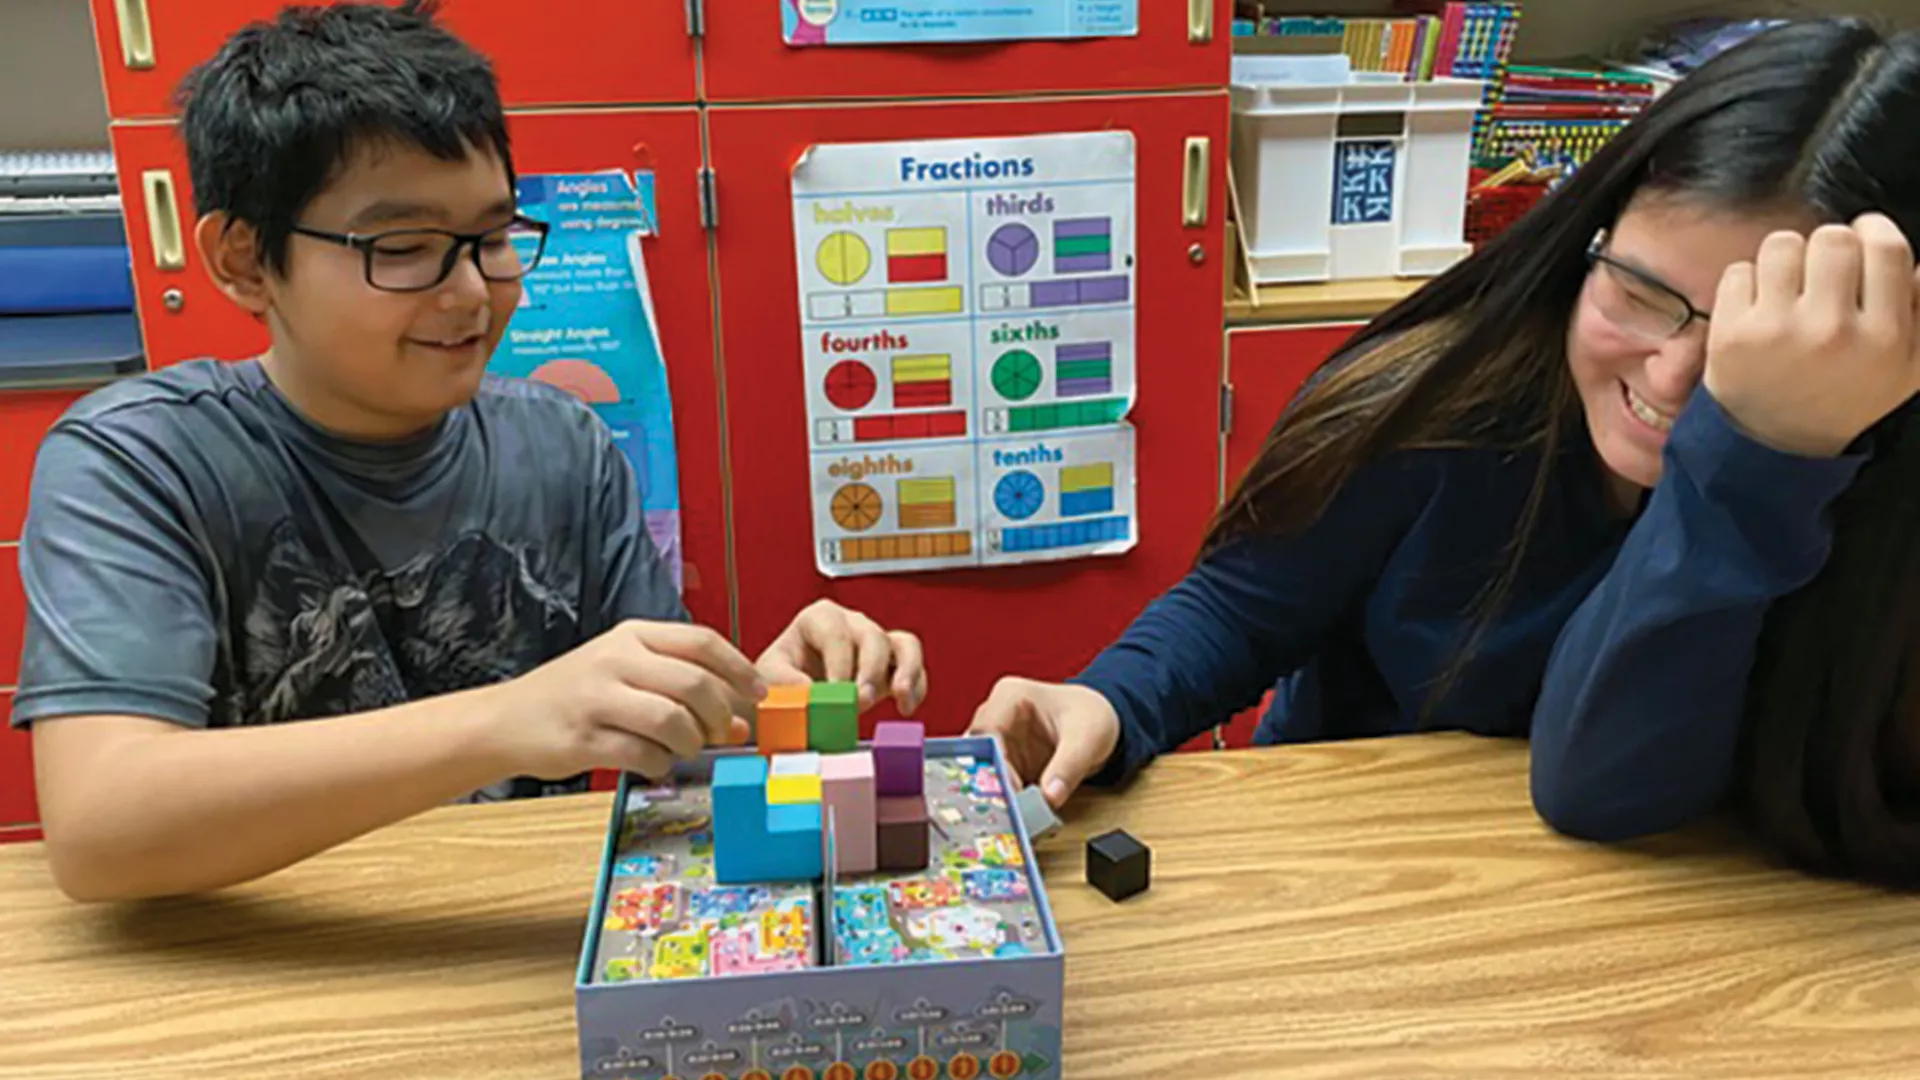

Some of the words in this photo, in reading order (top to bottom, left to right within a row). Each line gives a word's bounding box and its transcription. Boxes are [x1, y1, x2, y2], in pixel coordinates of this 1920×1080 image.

[900, 153, 1035, 181] Fractions
[813, 202, 894, 224] halves
[986, 193, 1054, 216] thirds
[821, 330, 909, 353] fourths
[990, 319, 1060, 343] sixths
[993, 442, 1064, 466] tenths
[828, 454, 914, 480] eighths
